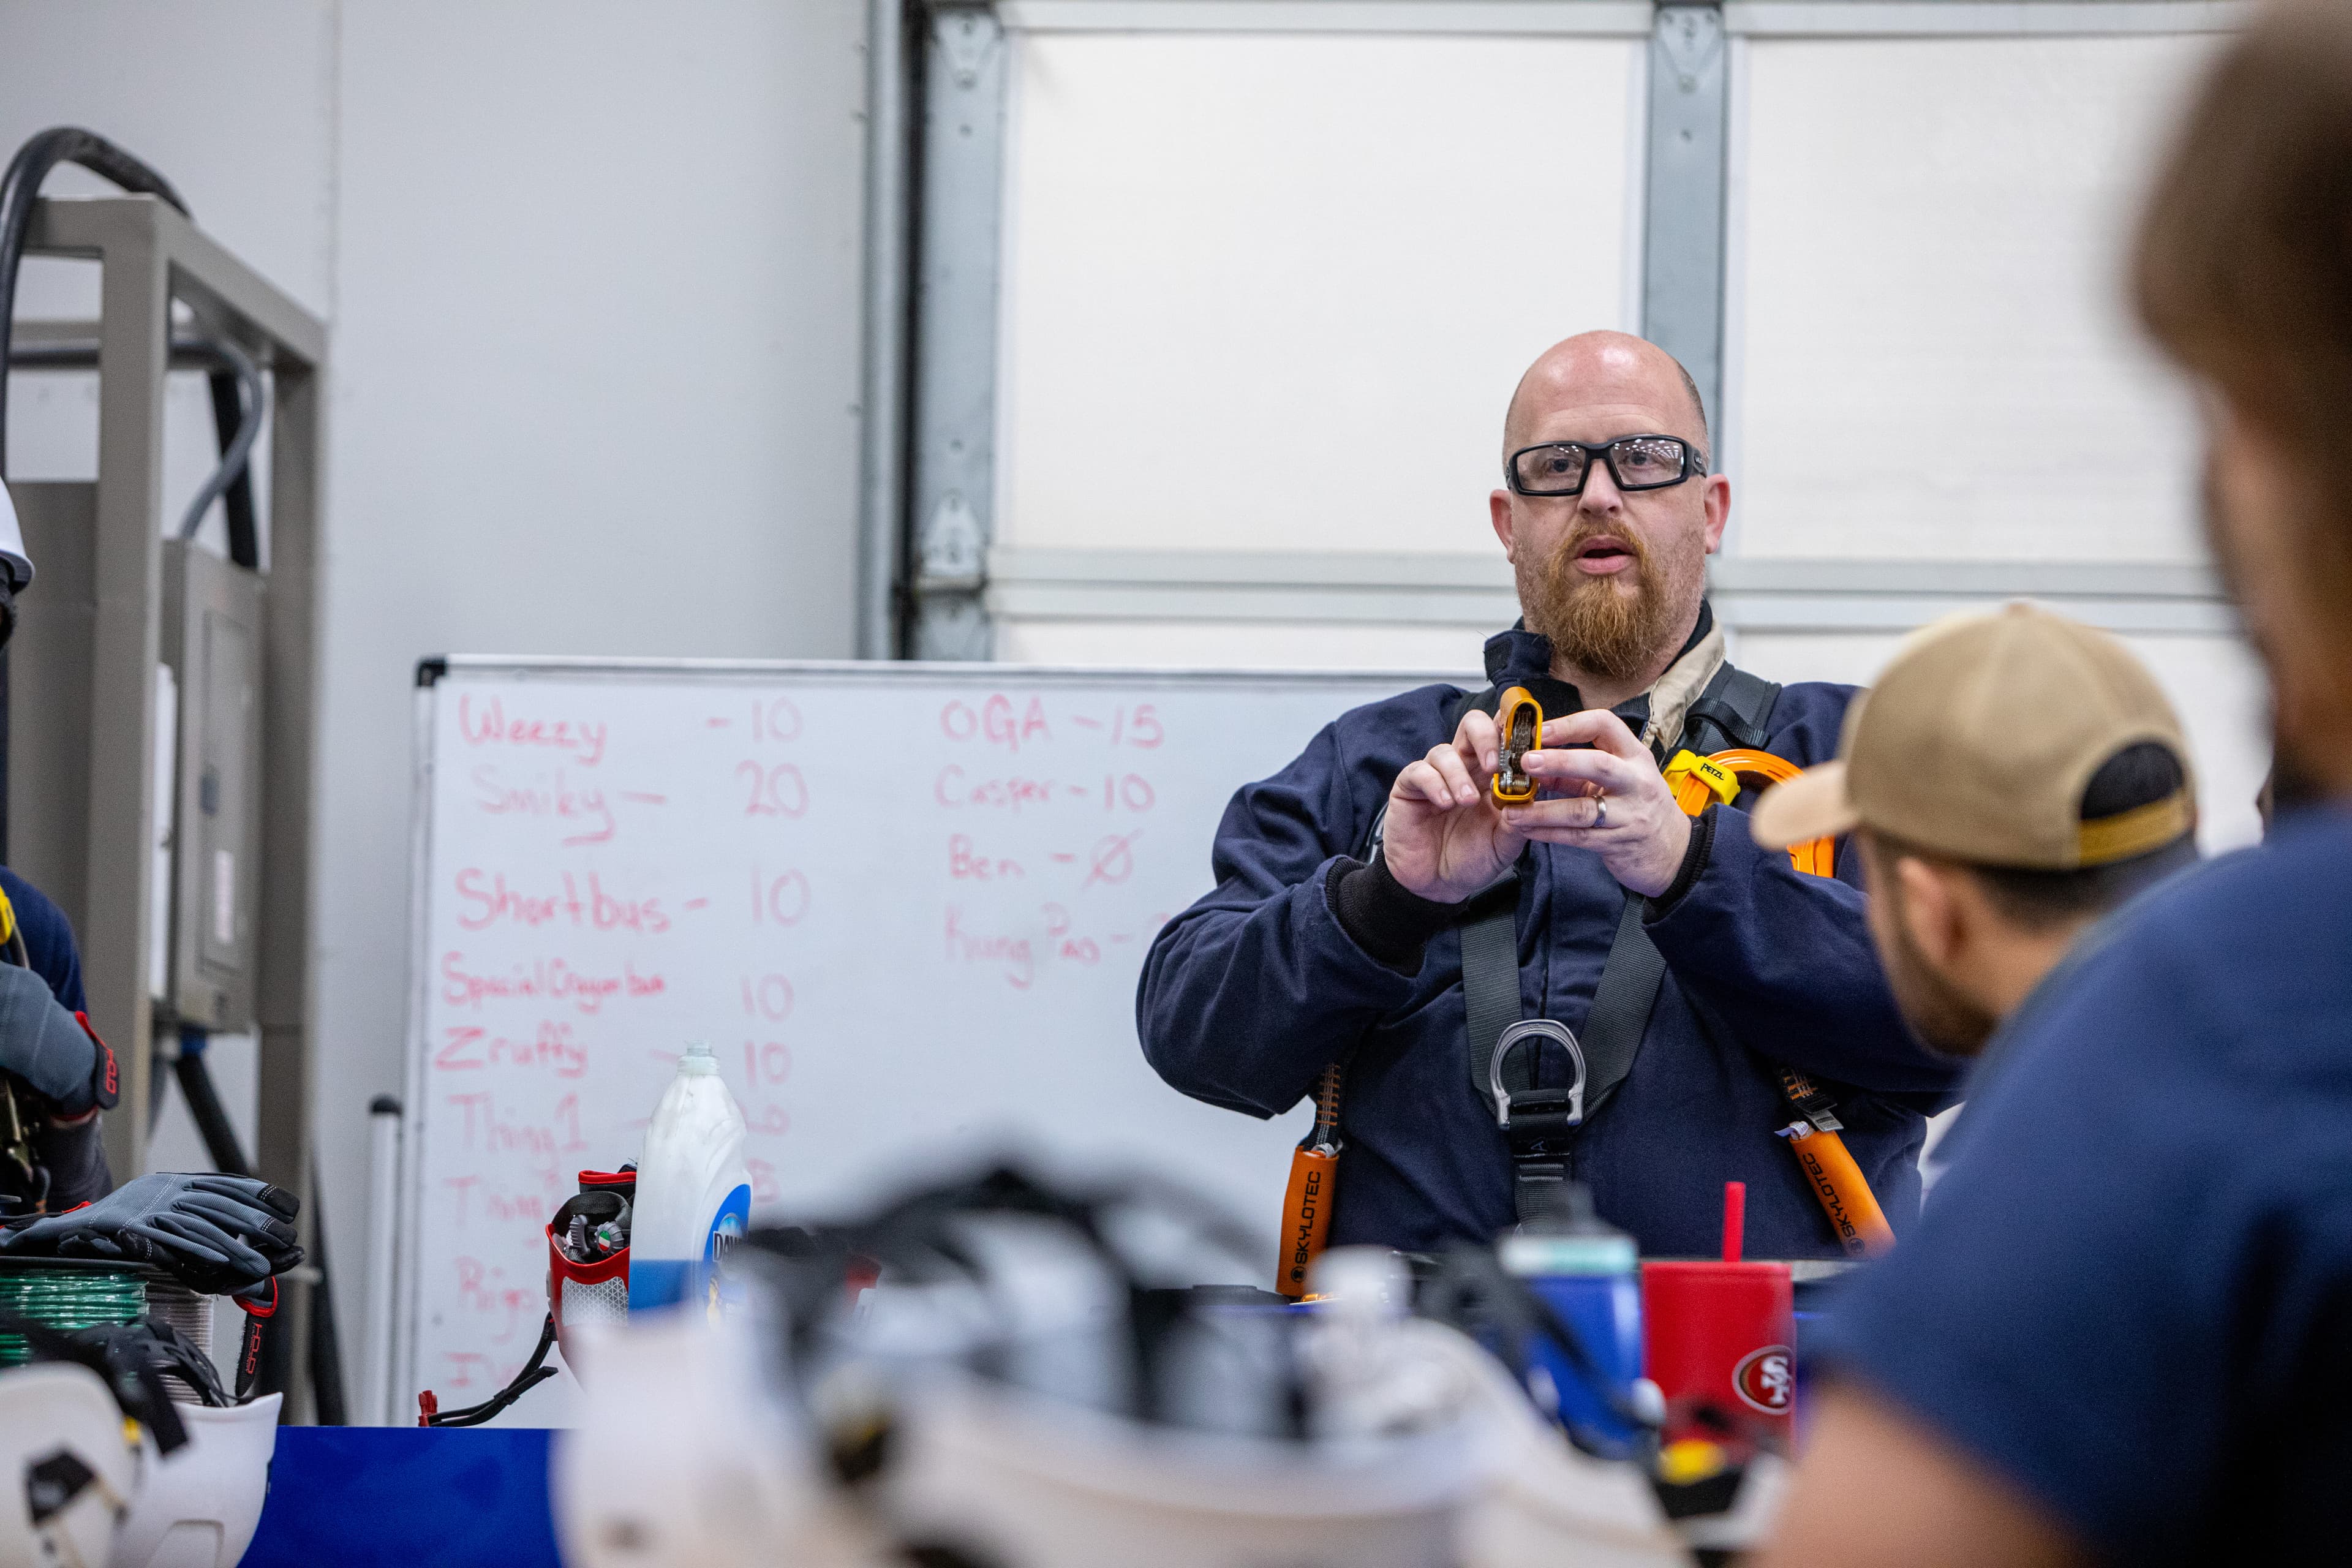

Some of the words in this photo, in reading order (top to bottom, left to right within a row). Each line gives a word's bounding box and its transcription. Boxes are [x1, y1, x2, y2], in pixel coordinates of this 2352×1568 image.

[752, 696, 804, 743] 10
[939, 693, 1054, 753] OGA
[1110, 703, 1165, 749] 15
[736, 758, 810, 819] 20
[1103, 772, 1156, 813] 10
[1700, 763, 1725, 781] PETZL
[948, 832, 1027, 882] Ben
[750, 864, 812, 927] 10
[741, 973, 795, 1022] 10
[744, 1039, 793, 1088] 10
[1294, 1170, 1321, 1265] SKYLOTEC
[1802, 1152, 1857, 1238] SKYLOTEC
